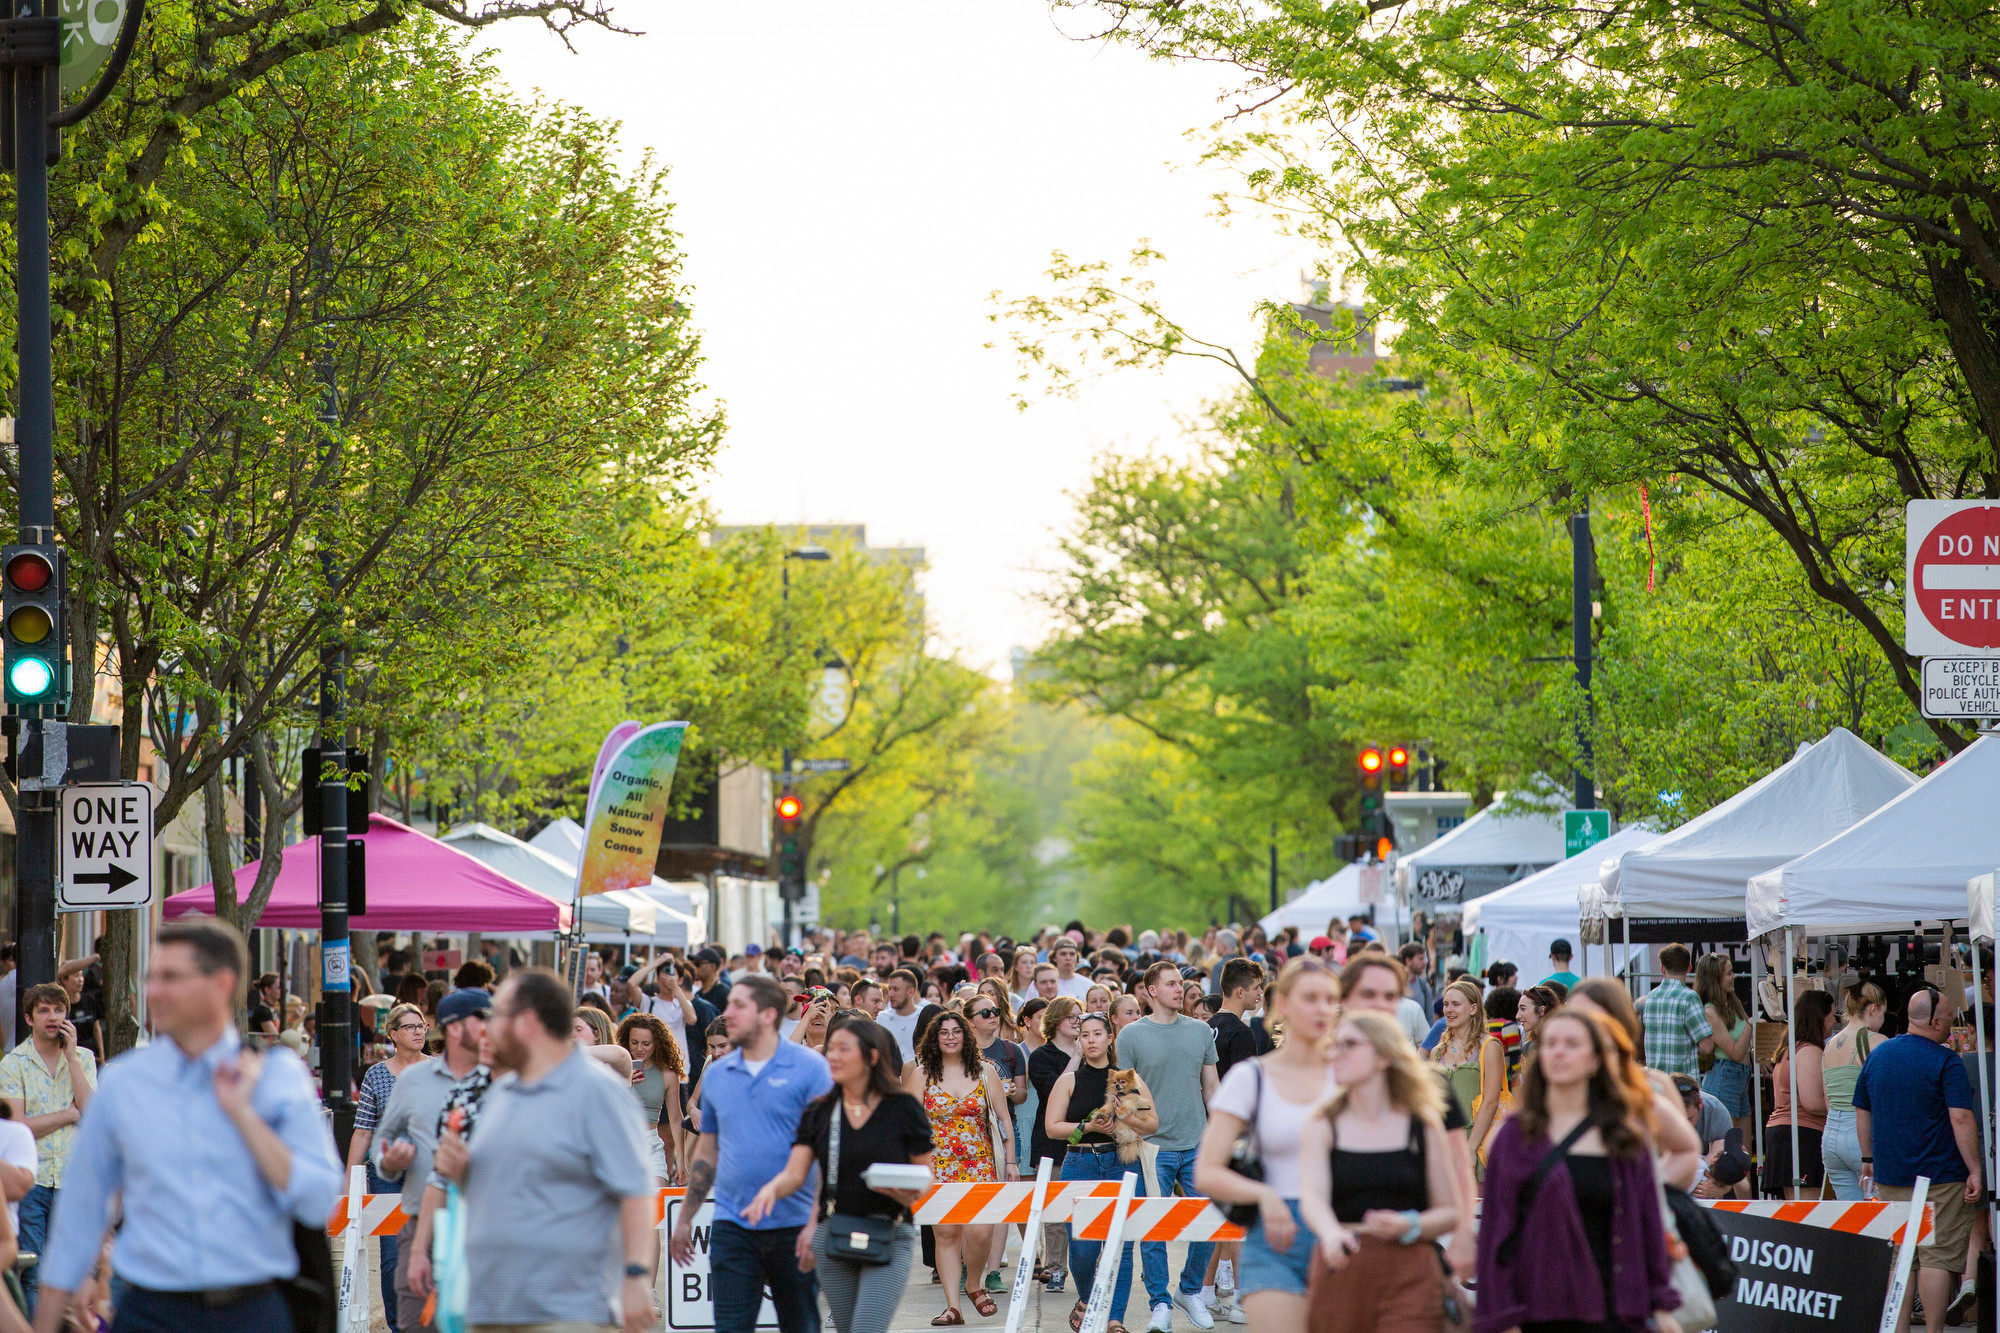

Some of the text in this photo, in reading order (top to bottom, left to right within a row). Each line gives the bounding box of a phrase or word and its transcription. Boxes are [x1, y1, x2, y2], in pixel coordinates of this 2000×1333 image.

[1938, 535, 1974, 557] DO
[1940, 598, 2000, 620] ENT
[1943, 661, 1986, 674] EXCEPT
[1929, 687, 1968, 700] POLICE
[612, 770, 663, 791] Organic,
[626, 791, 643, 802] All
[73, 797, 139, 825] ONE
[608, 804, 654, 822] Natural
[610, 822, 645, 838] Snow
[71, 831, 140, 858] WAY
[604, 839, 643, 855] Cones
[1721, 1234, 1814, 1275] DISON
[1736, 1277, 1843, 1320] MARKET
